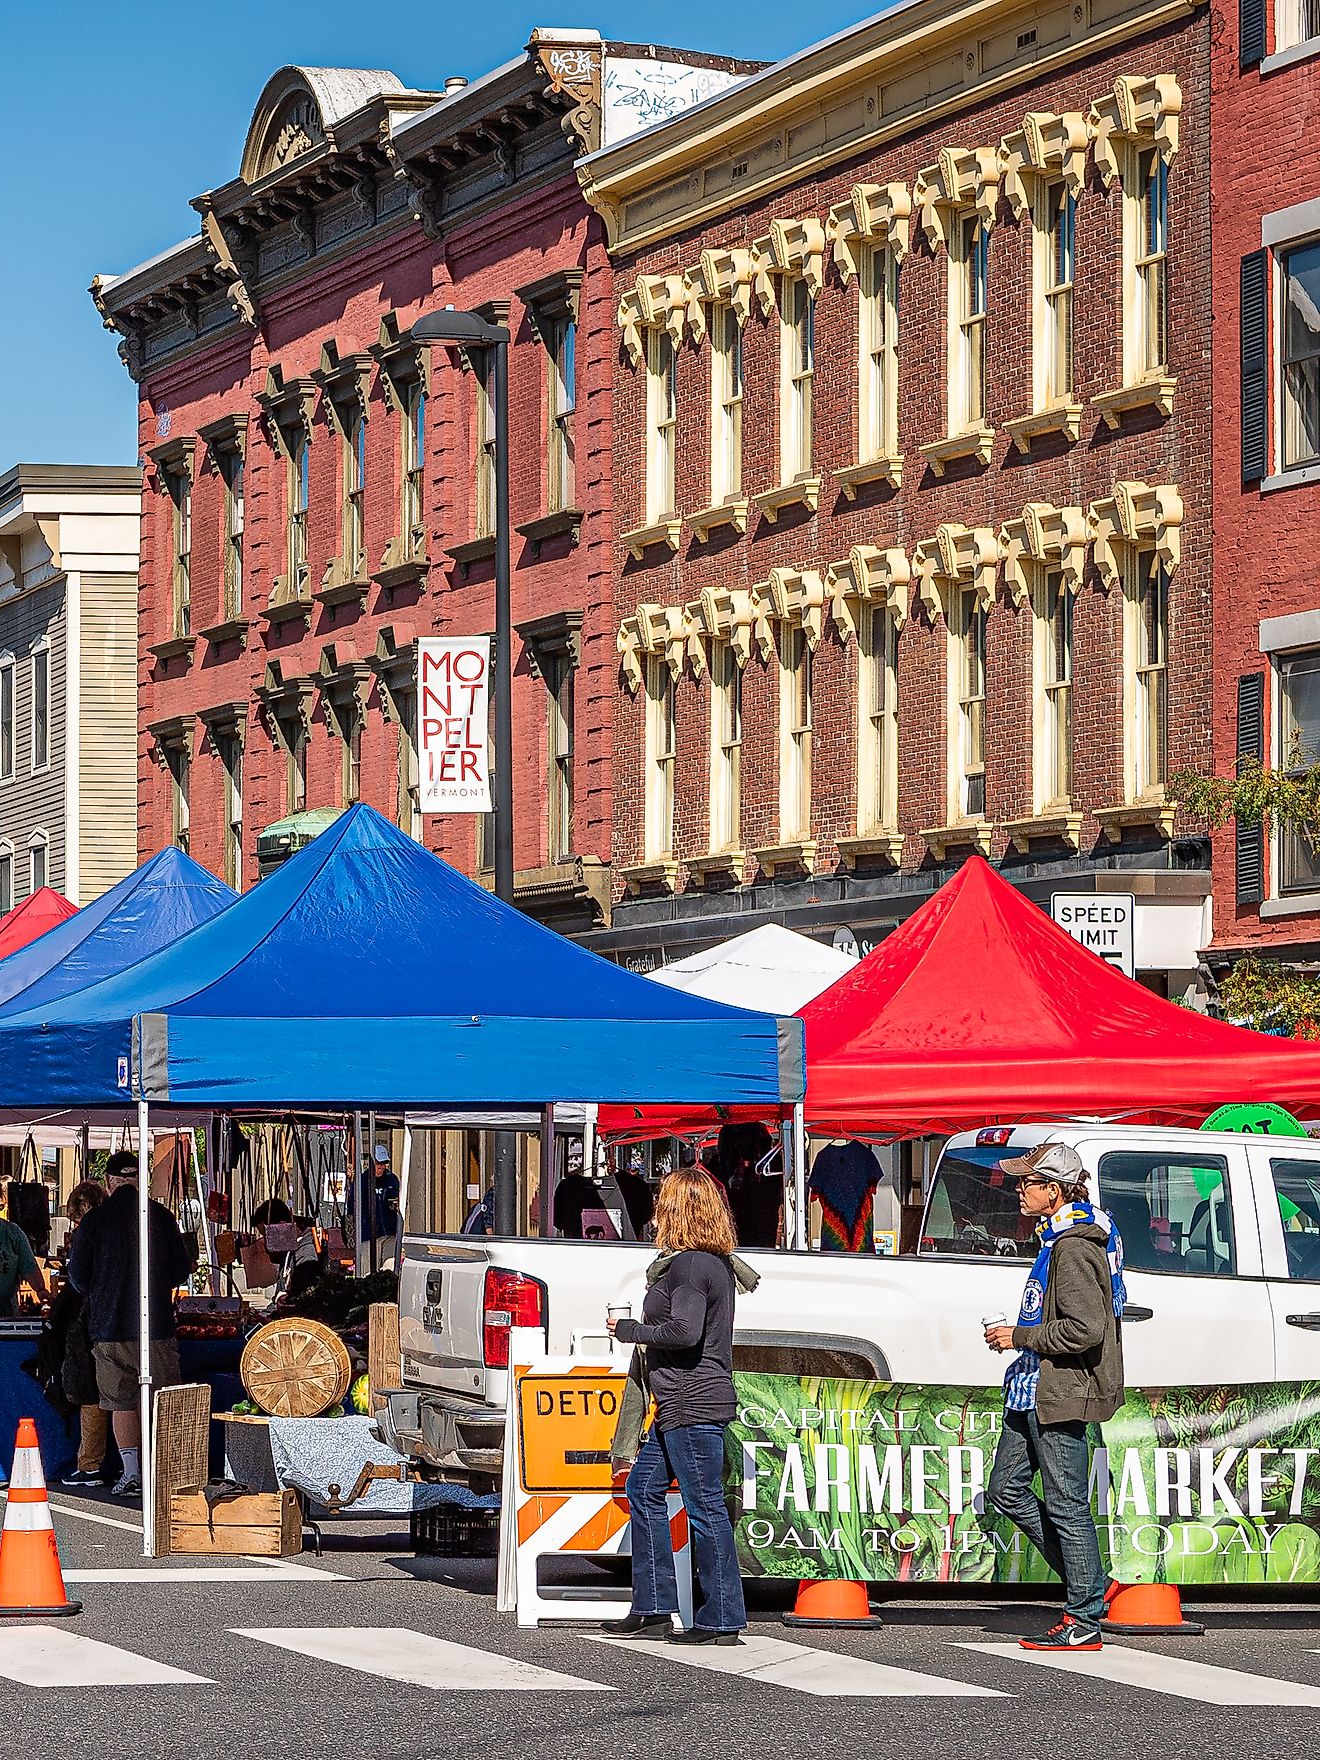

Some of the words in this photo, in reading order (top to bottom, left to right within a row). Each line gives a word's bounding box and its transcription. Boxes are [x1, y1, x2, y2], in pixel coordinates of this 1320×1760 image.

[422, 650, 485, 683] MO
[422, 684, 484, 716] NT
[422, 717, 483, 750] PEL
[428, 751, 483, 782] IER
[426, 788, 485, 797] VERMONT
[1060, 907, 1126, 923] SPEED
[625, 953, 656, 973] Grateful
[1223, 1119, 1273, 1135] AT
[536, 1390, 622, 1416] DETO
[740, 1406, 921, 1432] CAPITAL
[935, 1410, 1003, 1433] CIT
[741, 1440, 1003, 1516] FARMER
[747, 1519, 845, 1551] 9AM
[861, 1529, 920, 1553] TO
[941, 1524, 1025, 1553] 1PM
[1094, 1523, 1287, 1555] TODAY
